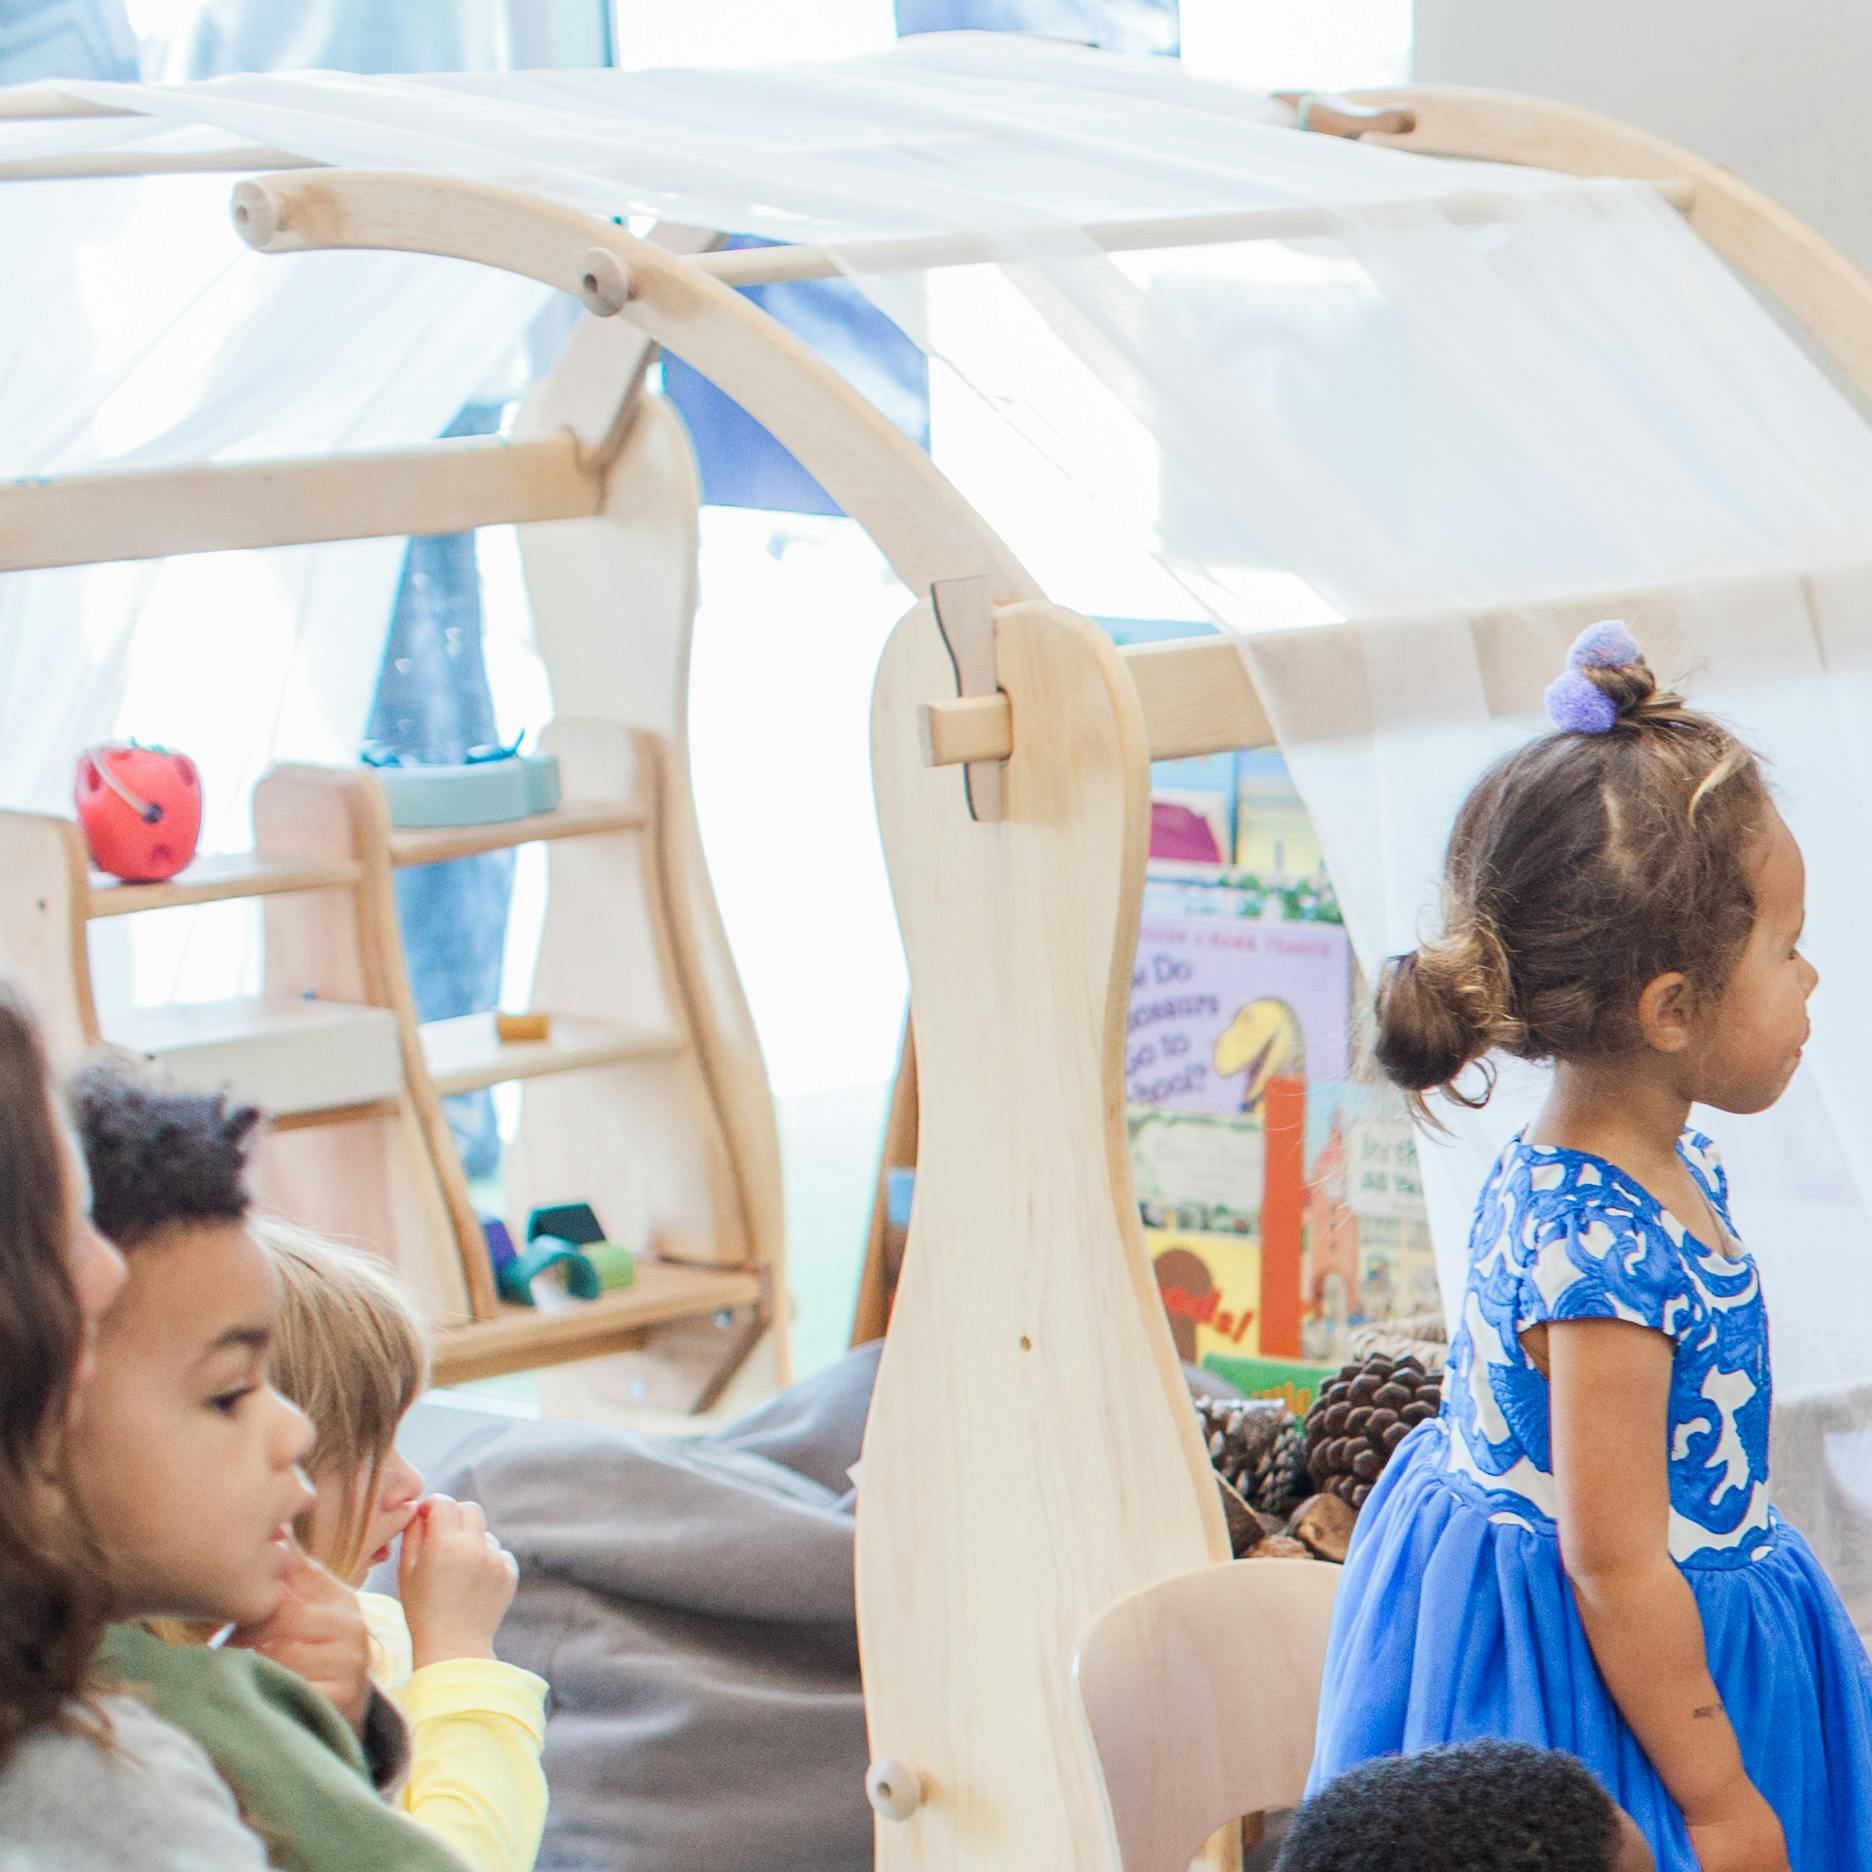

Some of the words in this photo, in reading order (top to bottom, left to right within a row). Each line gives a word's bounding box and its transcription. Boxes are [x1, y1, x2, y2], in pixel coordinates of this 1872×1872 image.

[1153, 953, 1192, 984] Do
[1128, 995, 1217, 1031] osaurs
[1127, 1062, 1206, 1103] hool?
